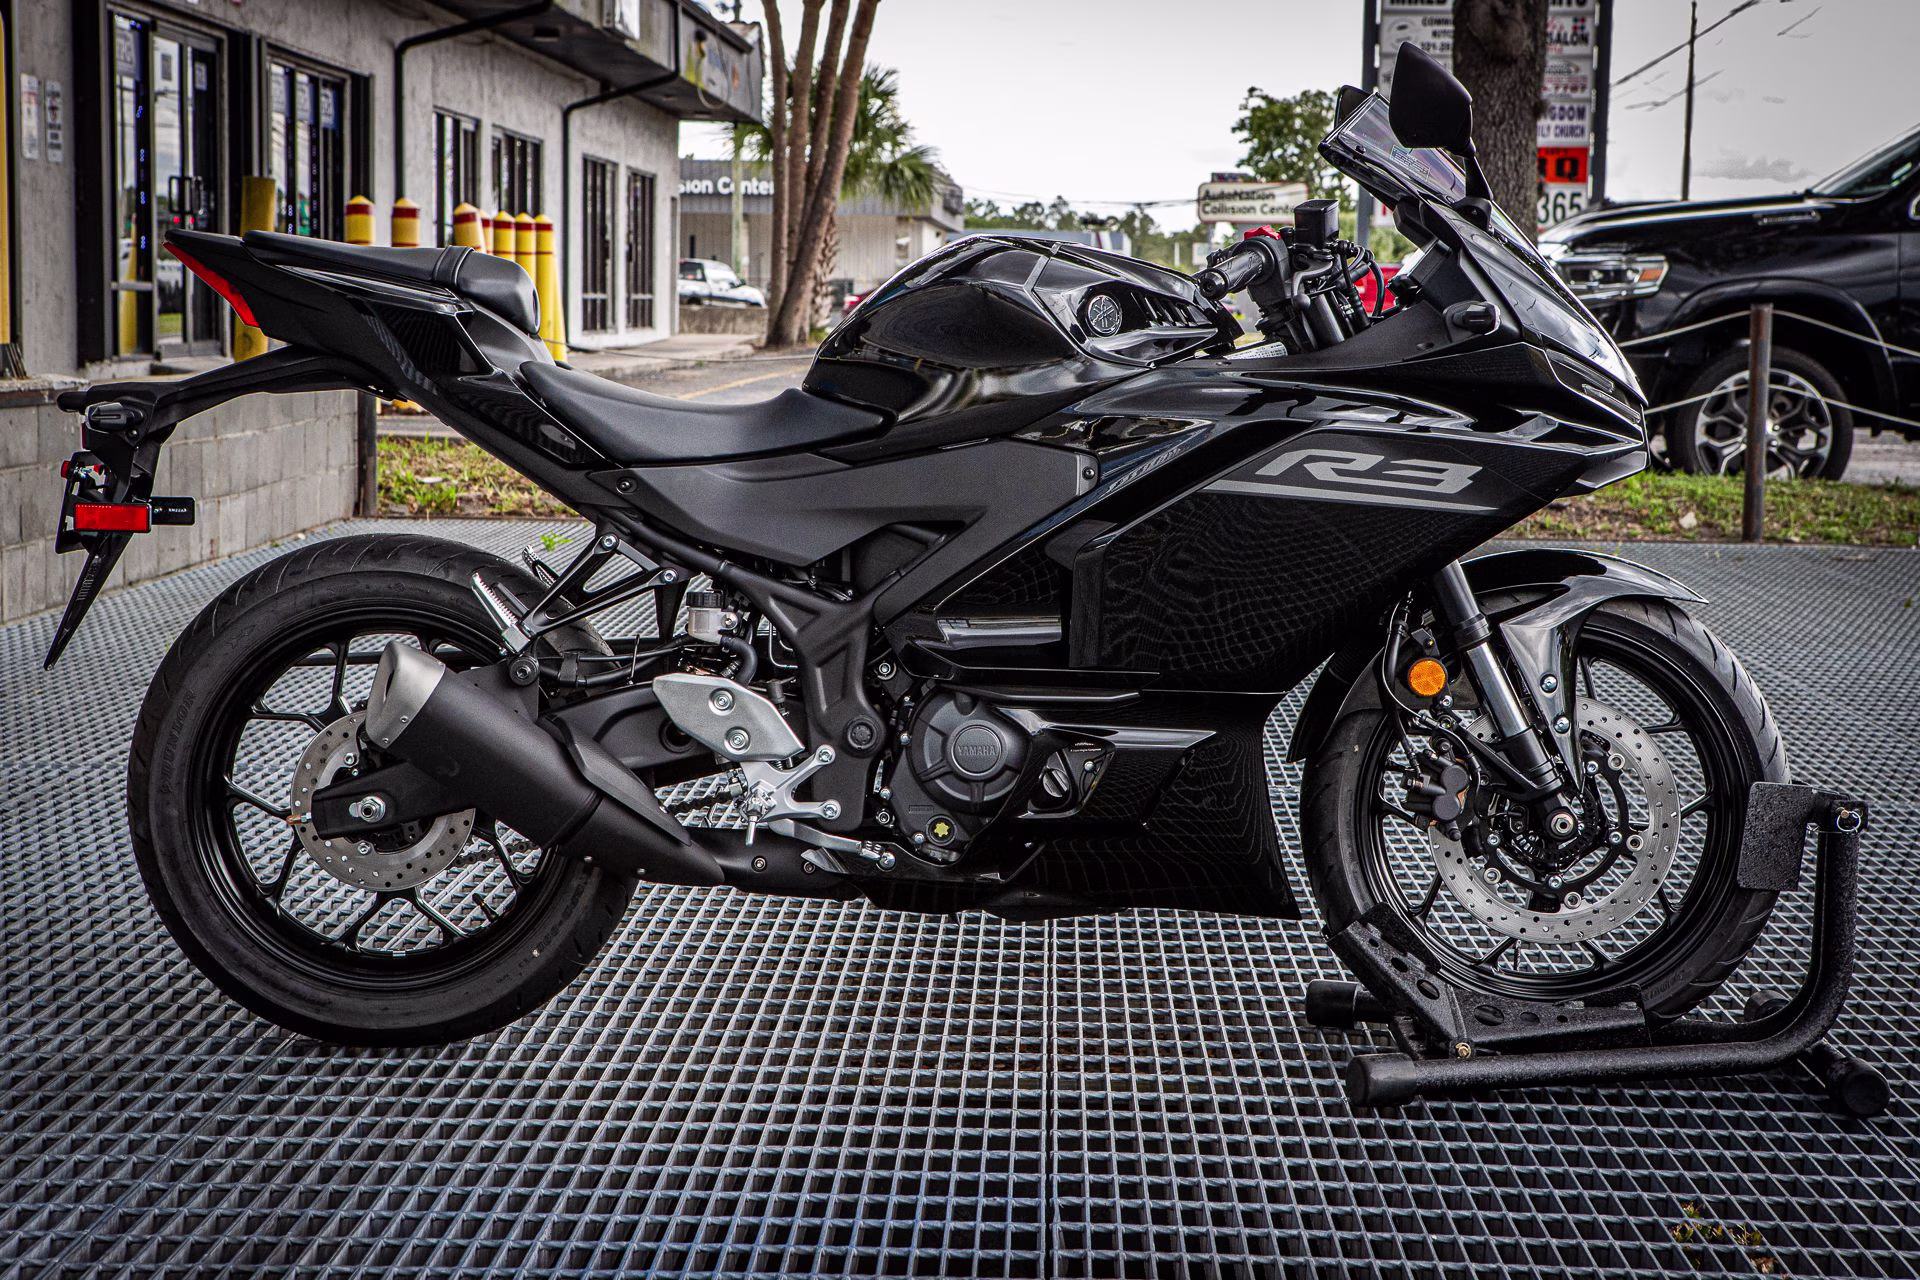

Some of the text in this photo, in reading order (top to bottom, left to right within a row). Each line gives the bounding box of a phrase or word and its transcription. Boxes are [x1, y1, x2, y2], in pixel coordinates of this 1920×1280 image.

[1554, 124, 1585, 138] CHURCH
[1202, 203, 1257, 214] Collision
[1254, 448, 1484, 494] R3
[957, 744, 997, 756] YAMAHA
